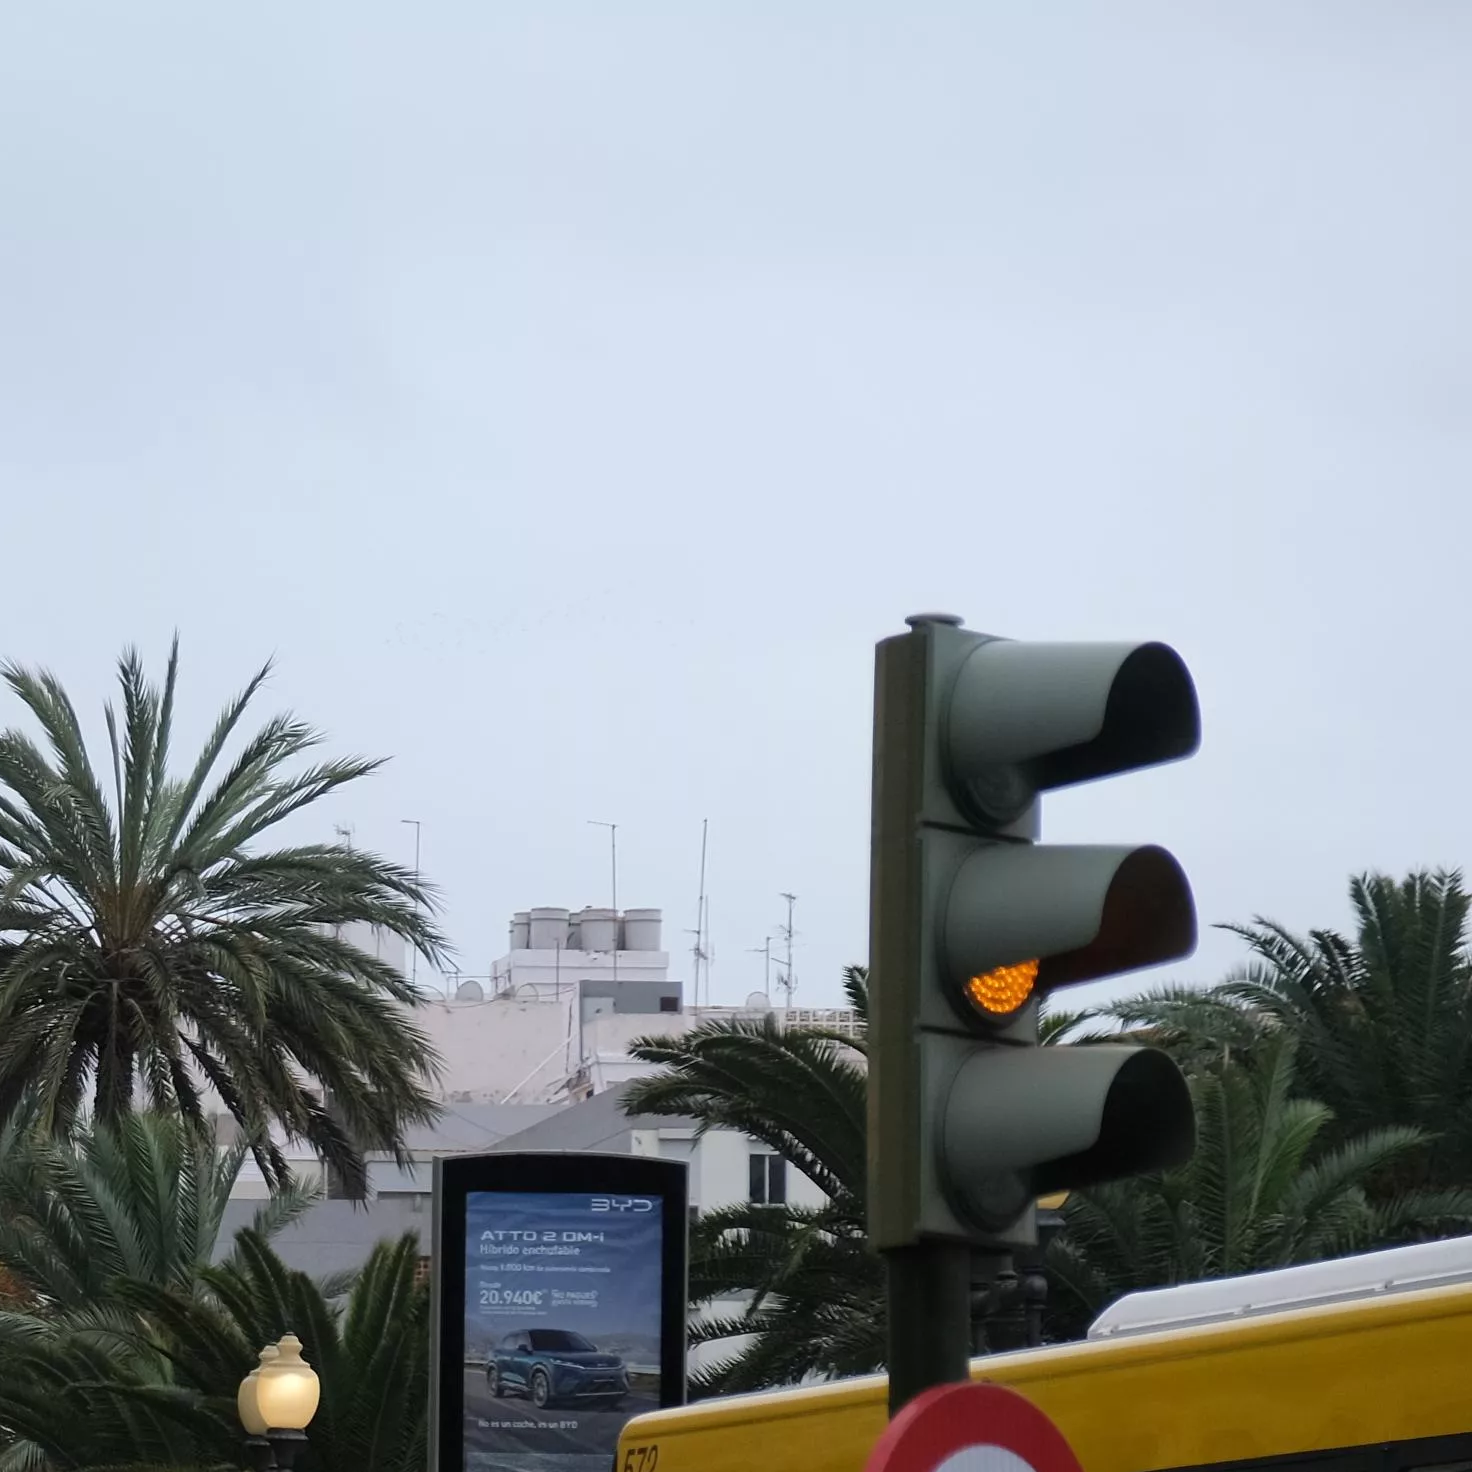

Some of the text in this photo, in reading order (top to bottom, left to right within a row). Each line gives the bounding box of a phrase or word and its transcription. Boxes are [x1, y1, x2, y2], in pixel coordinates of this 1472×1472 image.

[591, 1198, 653, 1212] BYD
[480, 1230, 605, 1243] ATTO 2 DM-i
[479, 1290, 543, 1305] 20.940€
